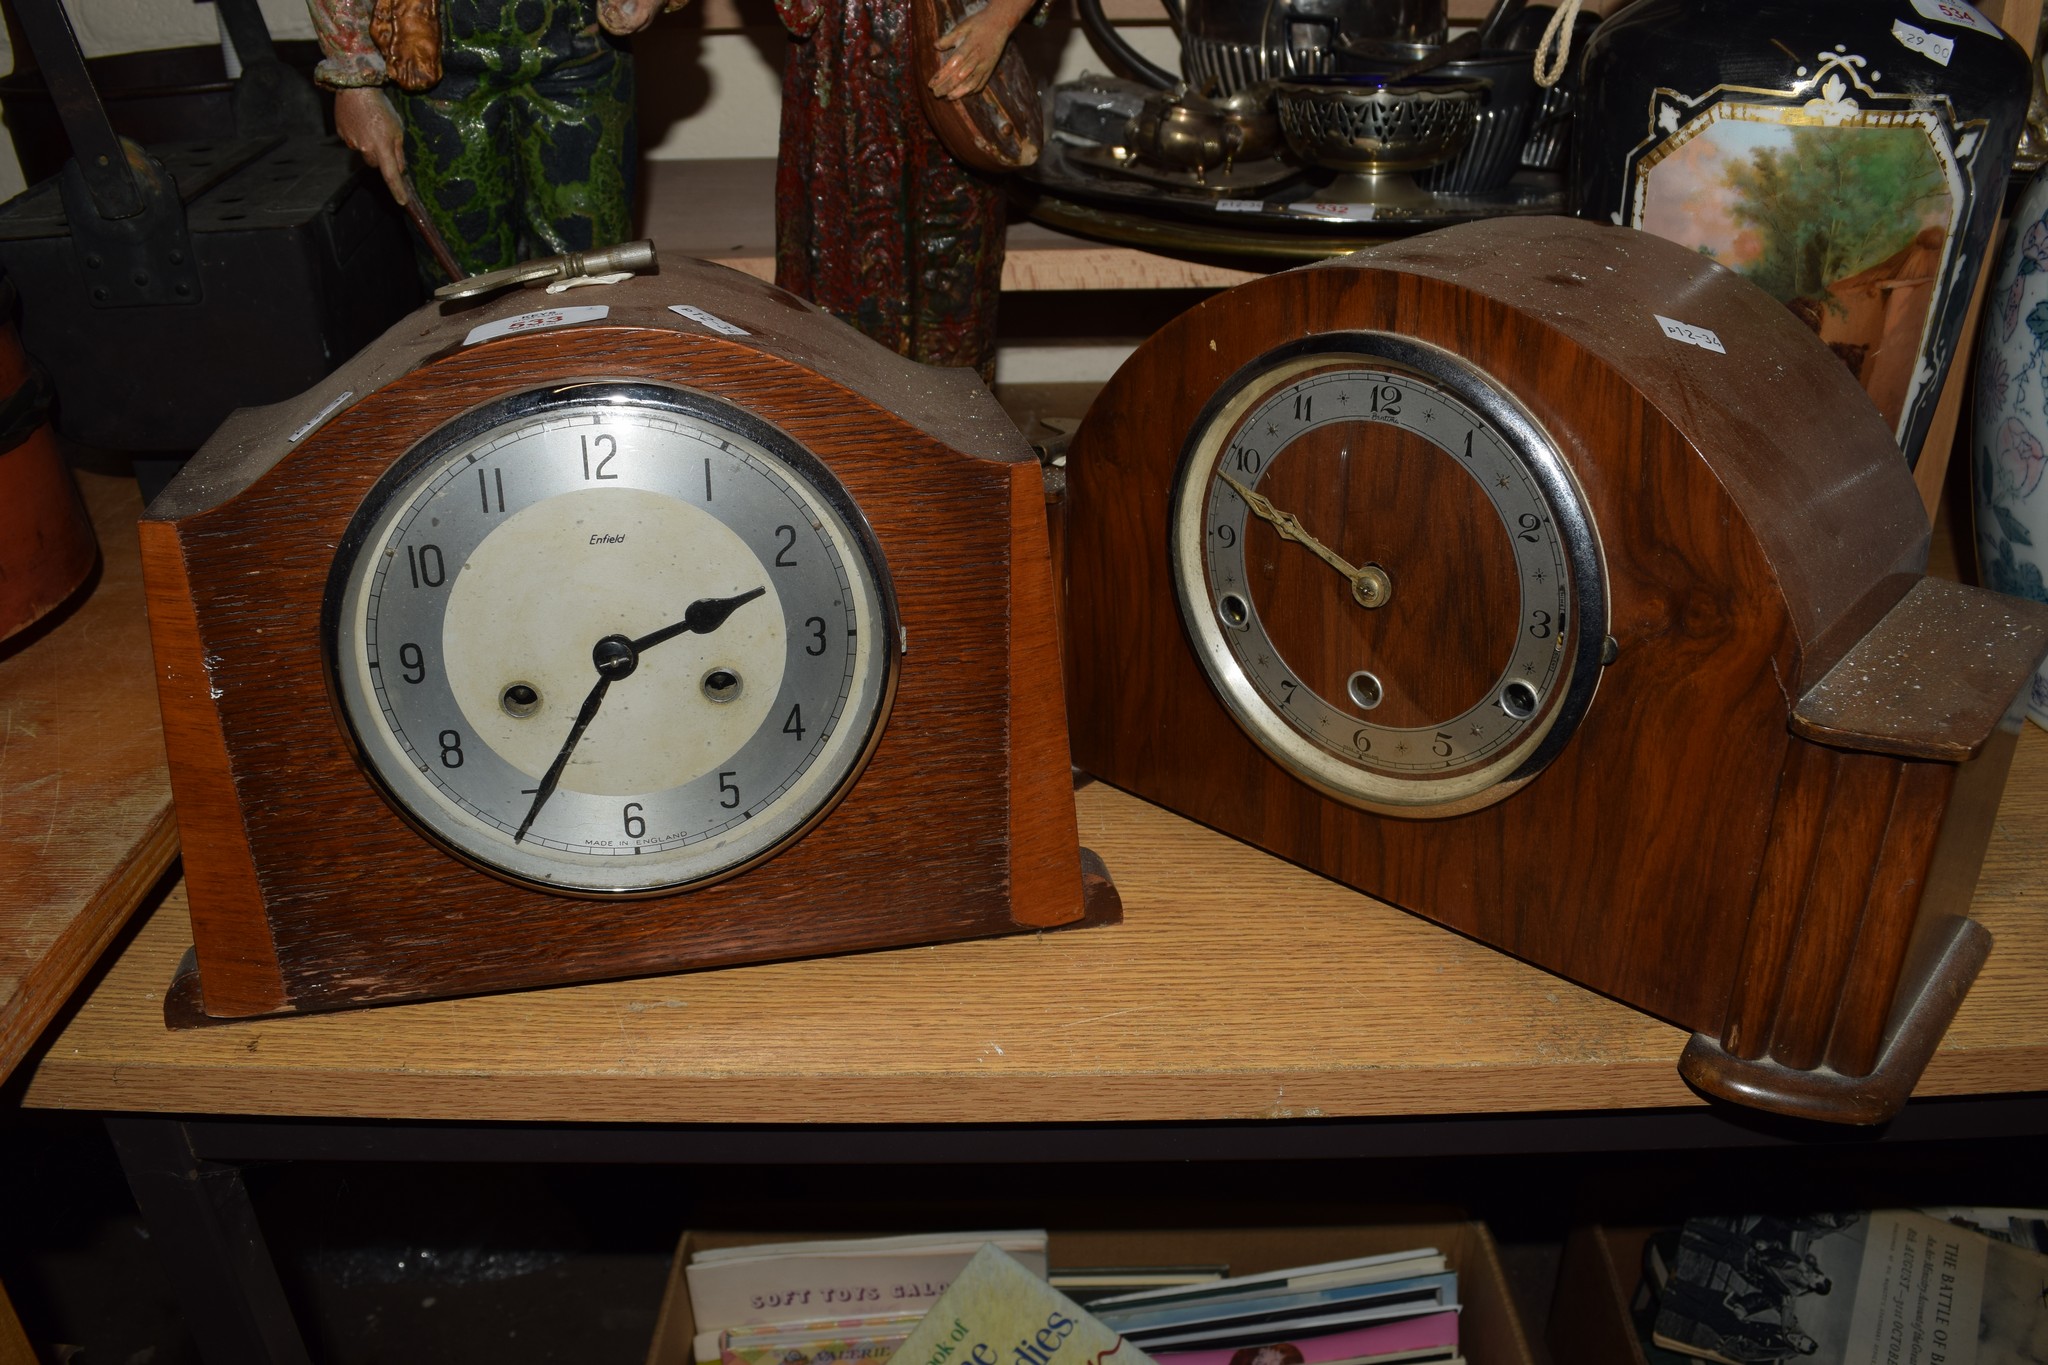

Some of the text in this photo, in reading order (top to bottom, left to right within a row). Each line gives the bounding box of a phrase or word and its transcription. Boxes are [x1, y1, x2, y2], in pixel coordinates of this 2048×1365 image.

[1938, 4, 1975, 23] 534
[1906, 33, 1924, 45] 29
[1316, 203, 1349, 214] 532
[508, 316, 563, 329] 533
[1293, 394, 1312, 423] 11
[1370, 385, 1402, 416] 12
[580, 433, 619, 480] 12
[1464, 428, 1475, 458] 1
[1235, 446, 1261, 474] 10
[478, 467, 506, 513] 11
[704, 457, 713, 502] 1
[589, 533, 626, 545] Enfield
[1216, 523, 1237, 549] 9
[1518, 512, 1542, 543] 2
[774, 524, 798, 568] 2
[407, 543, 446, 589] 10
[805, 615, 827, 656] 3
[1530, 609, 1552, 639] 3
[400, 642, 426, 684] 9
[1280, 679, 1299, 704] 7
[782, 702, 806, 741] 4
[439, 729, 465, 768] 8
[1352, 728, 1372, 753] 6
[1432, 731, 1454, 758] 5
[718, 771, 741, 809] 5
[623, 801, 647, 839] 6
[585, 839, 613, 847] MADE
[636, 831, 688, 846] ENGLAND
[1943, 1243, 1960, 1271] THE
[751, 1289, 811, 1310] SOFT
[819, 1286, 881, 1305] TOYS
[1935, 1273, 1956, 1326] BATTLE
[951, 1318, 970, 1343] of
[1933, 1329, 1948, 1351] OF
